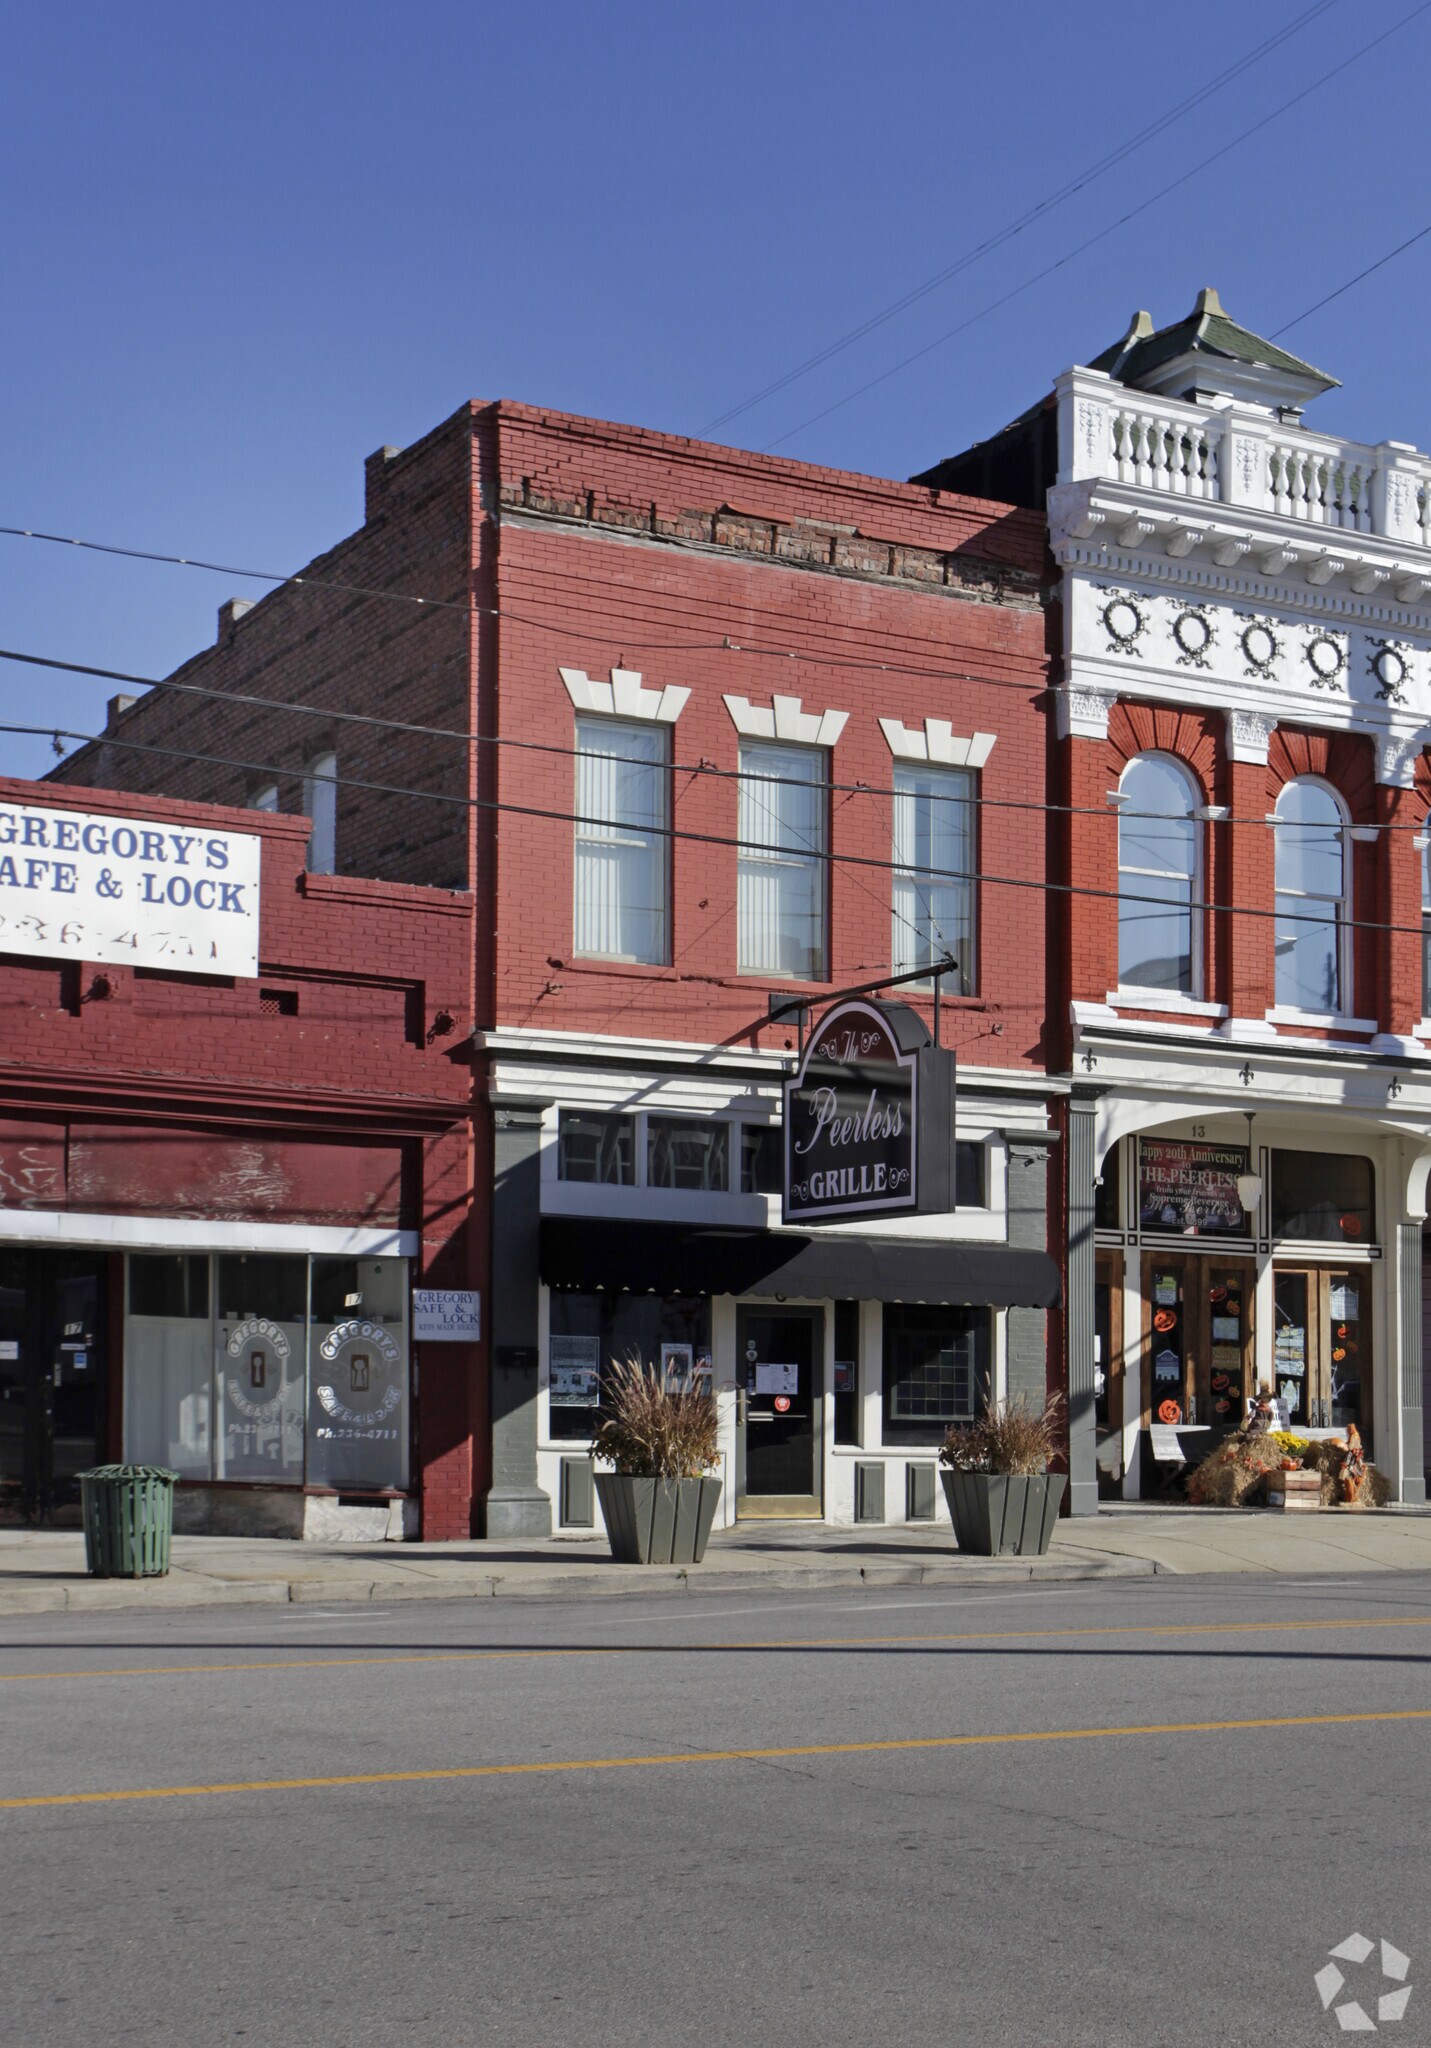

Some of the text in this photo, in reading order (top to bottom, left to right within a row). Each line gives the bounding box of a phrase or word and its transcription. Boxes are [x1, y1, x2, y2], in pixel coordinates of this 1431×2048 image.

[0, 812, 229, 870] GREGORY'S
[95, 867, 123, 899] &
[141, 872, 246, 915] LOCK
[0, 914, 218, 960] 36-4711
[839, 1030, 859, 1065] The
[794, 1086, 905, 1154] Peerless
[1191, 1125, 1206, 1138] 13
[1165, 1145, 1187, 1160] 20th
[1188, 1147, 1245, 1169] Anniversary
[810, 1162, 887, 1199] GRILLE
[413, 1303, 466, 1313] SAFE &
[418, 1291, 474, 1303] GREGORY
[442, 1313, 478, 1324] LOCK
[228, 1318, 290, 1357] GREGORY'S
[320, 1320, 400, 1361] GREGORY'S
